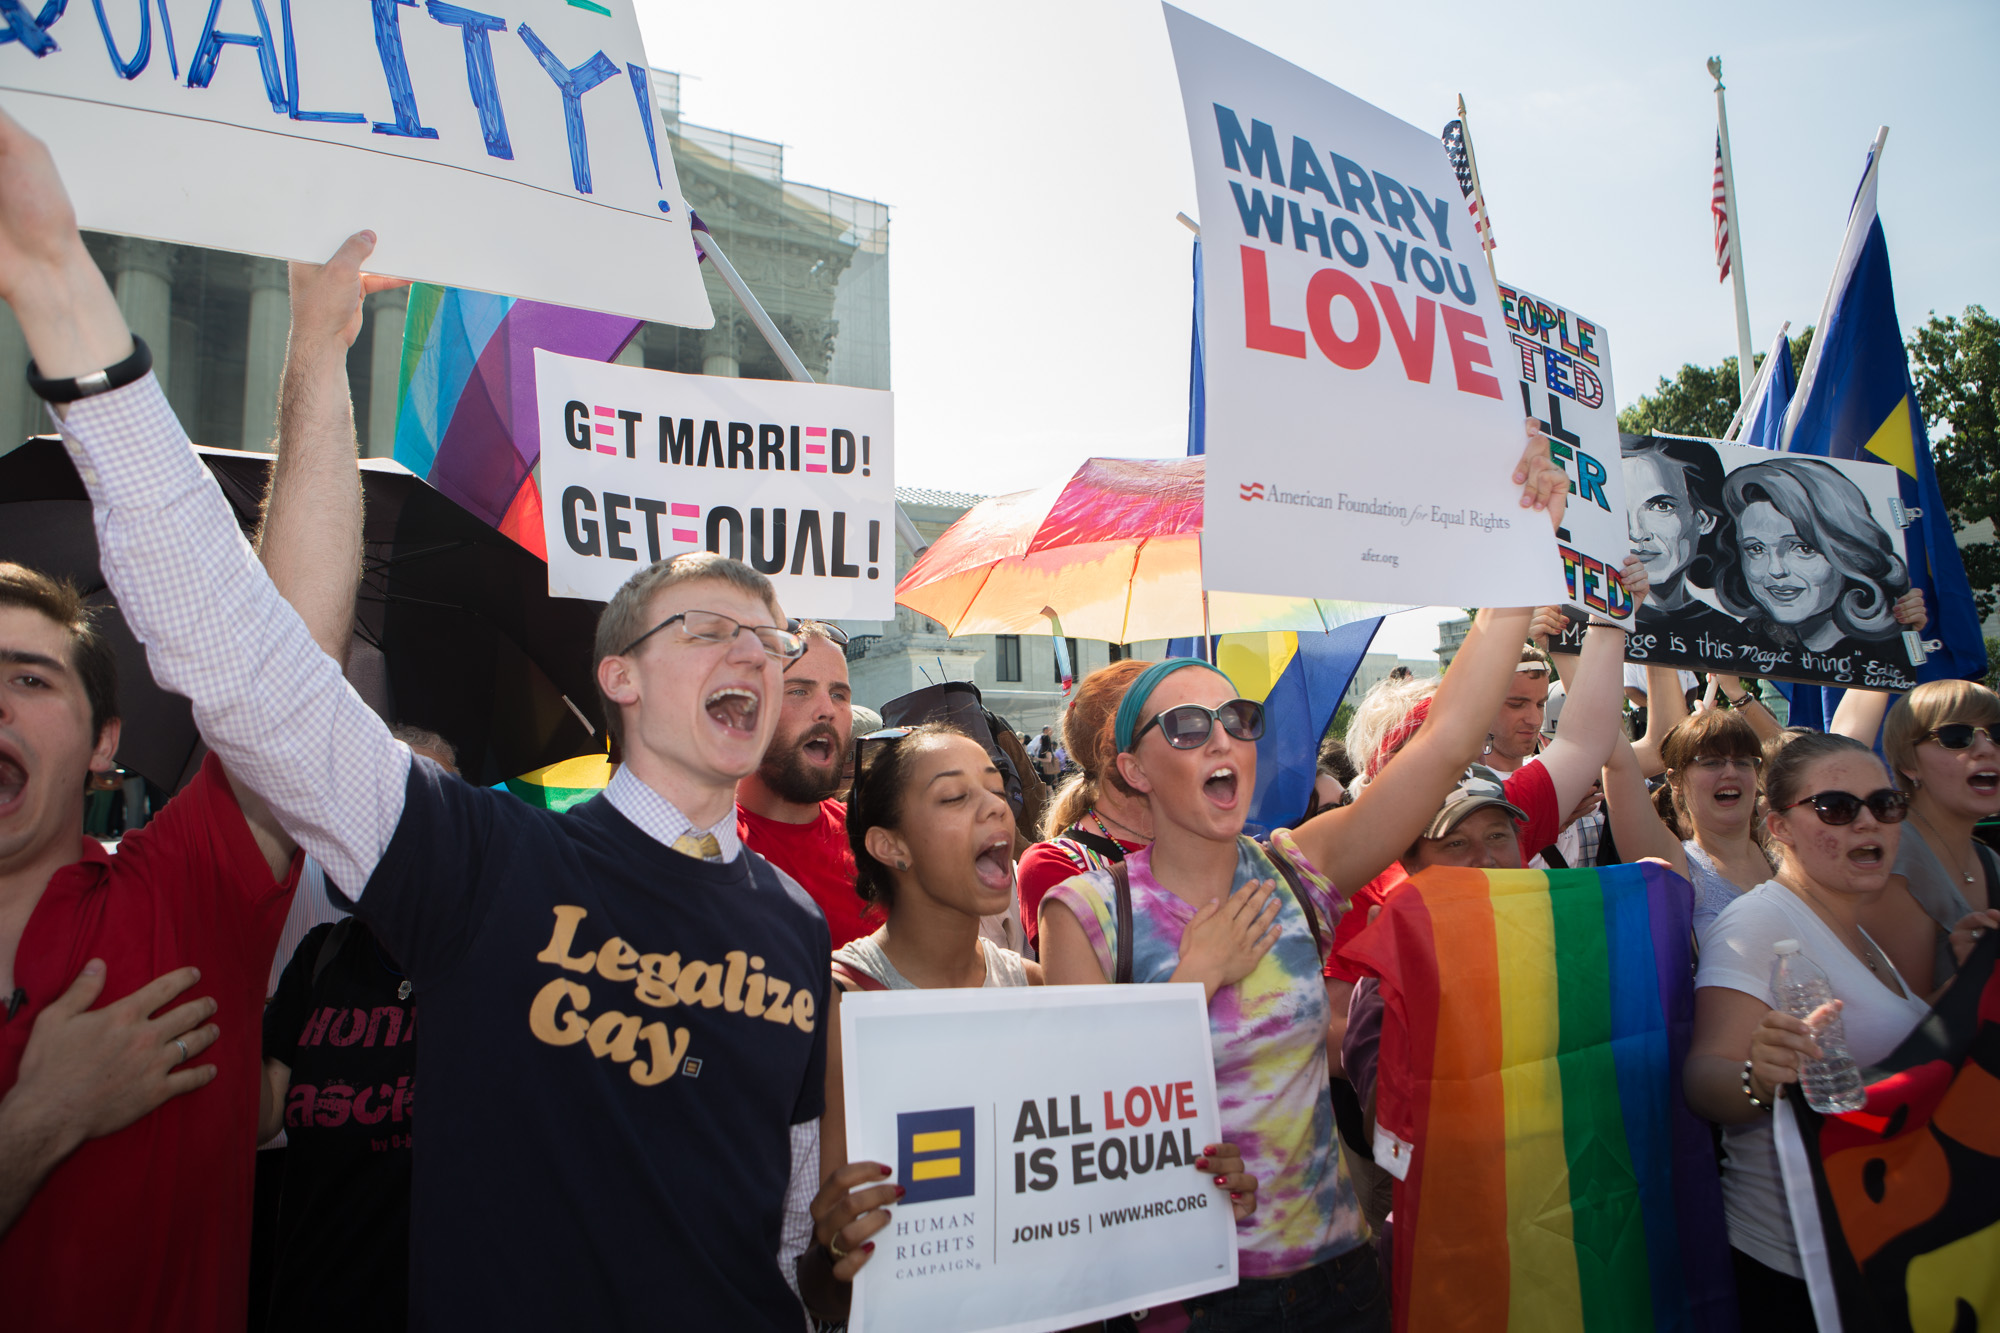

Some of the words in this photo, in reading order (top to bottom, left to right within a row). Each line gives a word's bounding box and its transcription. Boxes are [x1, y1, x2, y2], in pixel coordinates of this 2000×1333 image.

[1212, 102, 1453, 251] MARRY
[1228, 180, 1369, 268] WHO
[1374, 230, 1477, 306] YOU
[1240, 244, 1504, 400] LOVE
[564, 400, 642, 459] GET
[659, 415, 870, 477] MARRIED!
[1266, 484, 1333, 509] American
[1337, 492, 1407, 518] Foundation
[1400, 504, 1428, 527] for
[1431, 505, 1465, 529] Equal
[1469, 510, 1511, 533] Rights
[1361, 548, 1399, 568] afer.org
[1669, 631, 1688, 654] is
[1696, 631, 1734, 660] this
[537, 904, 815, 1033] Legalize
[529, 977, 690, 1086] Gay
[1013, 1095, 1092, 1143] ALL
[1103, 1080, 1198, 1131] LOVE
[1014, 1147, 1058, 1193] IS
[1071, 1127, 1202, 1185] EQUAL
[896, 1235, 975, 1260] RIGHTS
[897, 1211, 975, 1236] HUMAN
[1012, 1223, 1053, 1244] JOIN
[1058, 1218, 1081, 1237] US
[1100, 1193, 1208, 1228] WWW.HRC.ORG
